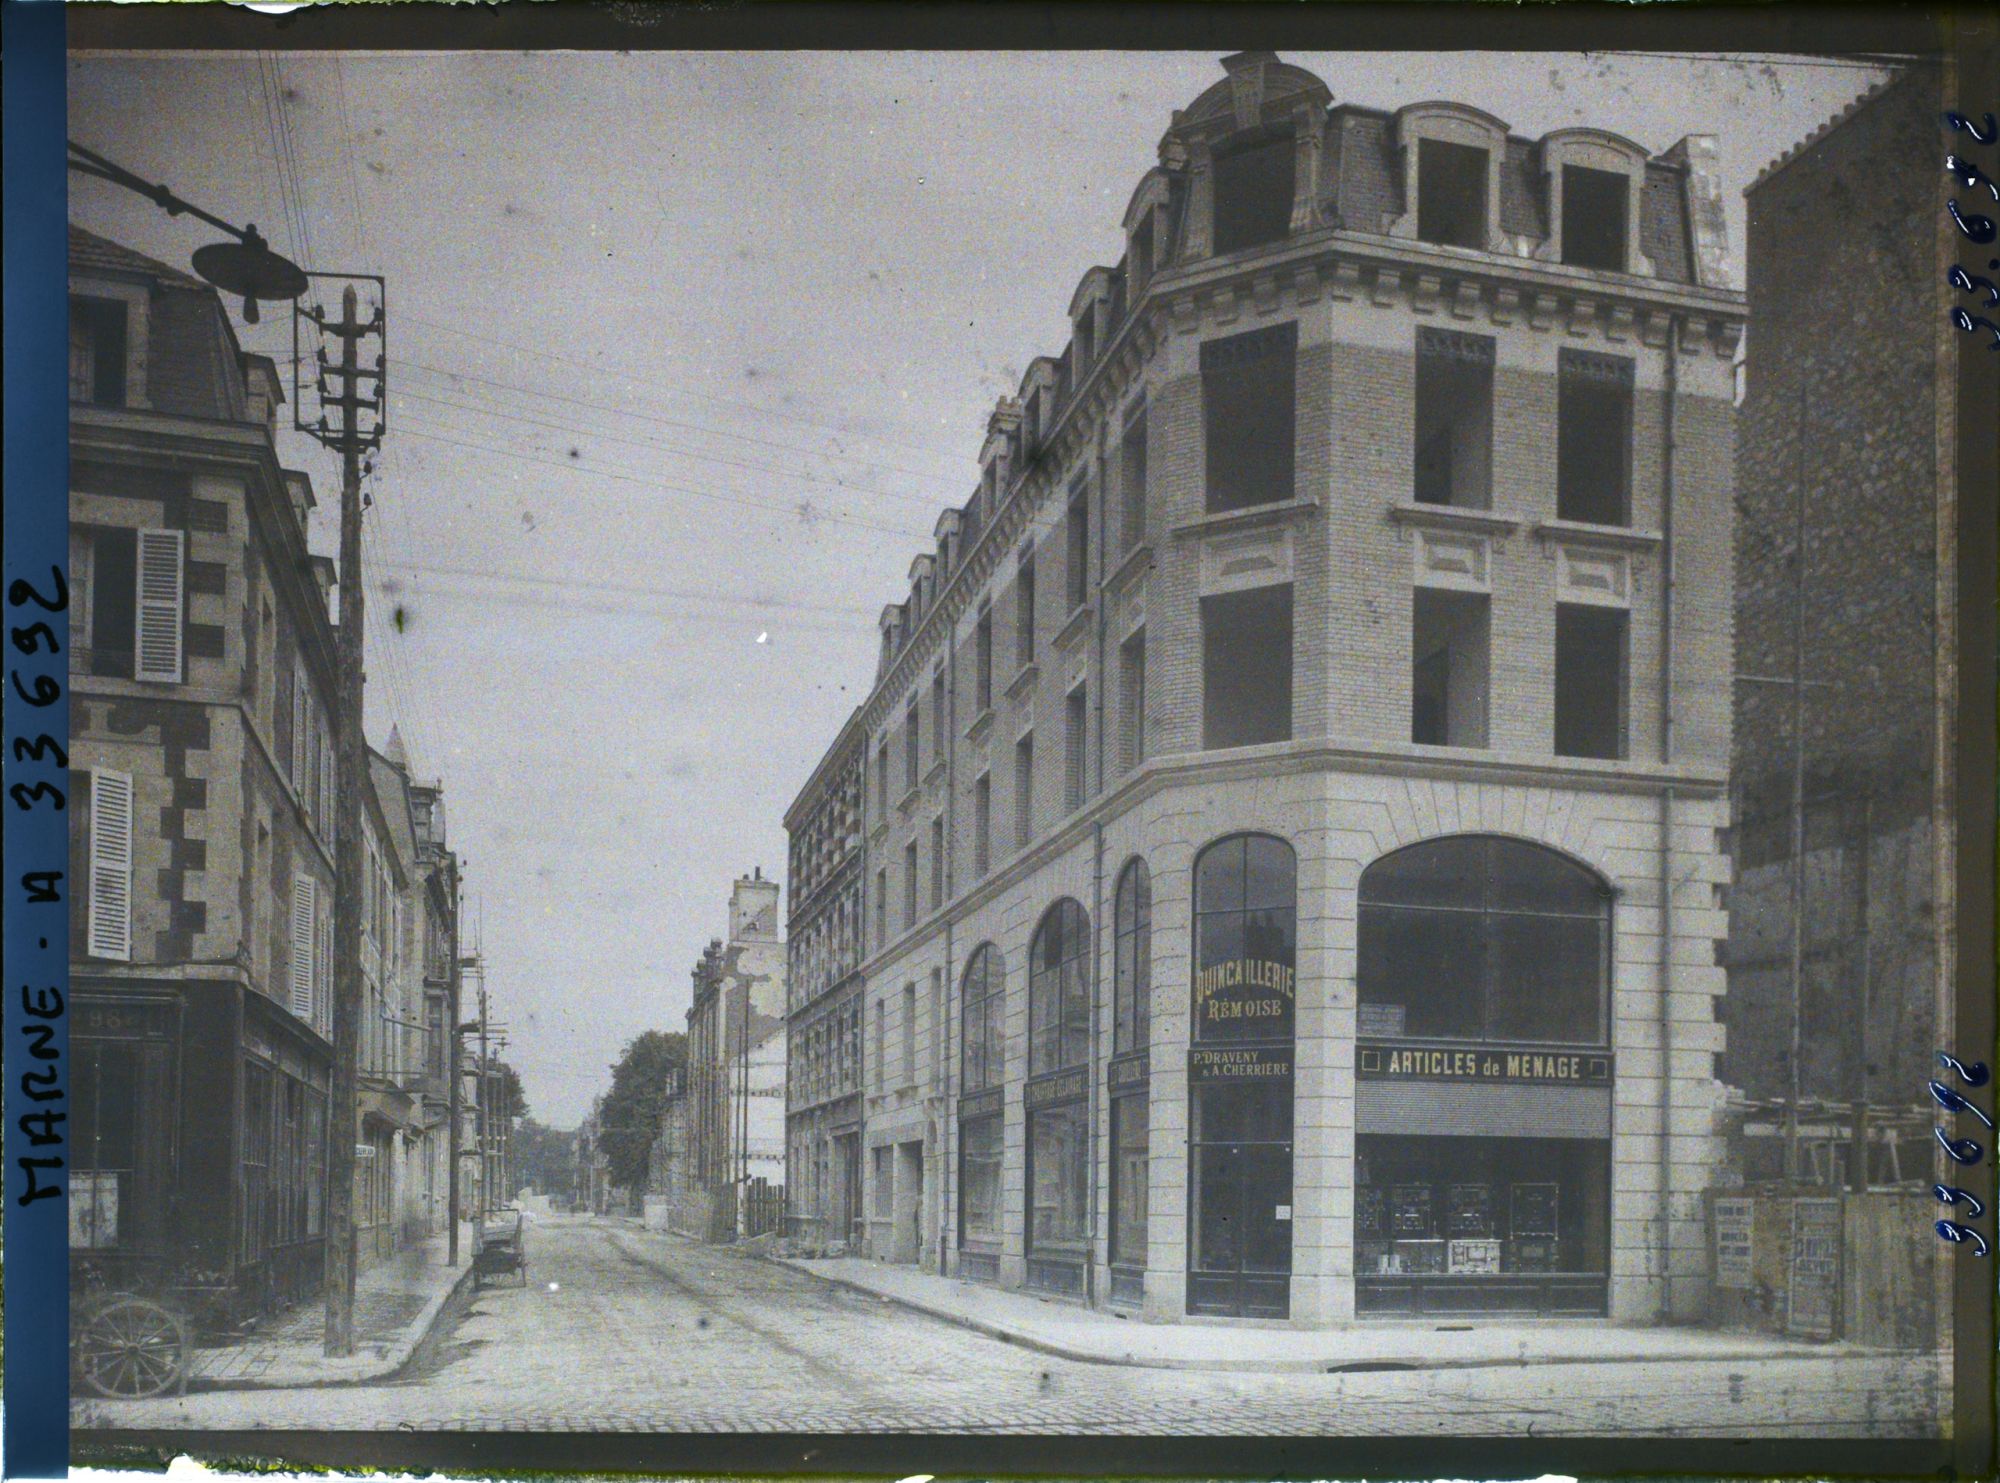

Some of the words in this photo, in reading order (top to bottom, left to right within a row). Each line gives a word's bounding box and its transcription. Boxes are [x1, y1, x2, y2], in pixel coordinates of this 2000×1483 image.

[8, 564, 69, 812] 33692
[21, 870, 64, 902] A
[1196, 959, 1294, 1004] QUINCAILLERIE
[1389, 1050, 1477, 1076] ARTICLES
[1483, 1056, 1500, 1076] de
[17, 984, 67, 1207] MARNE
